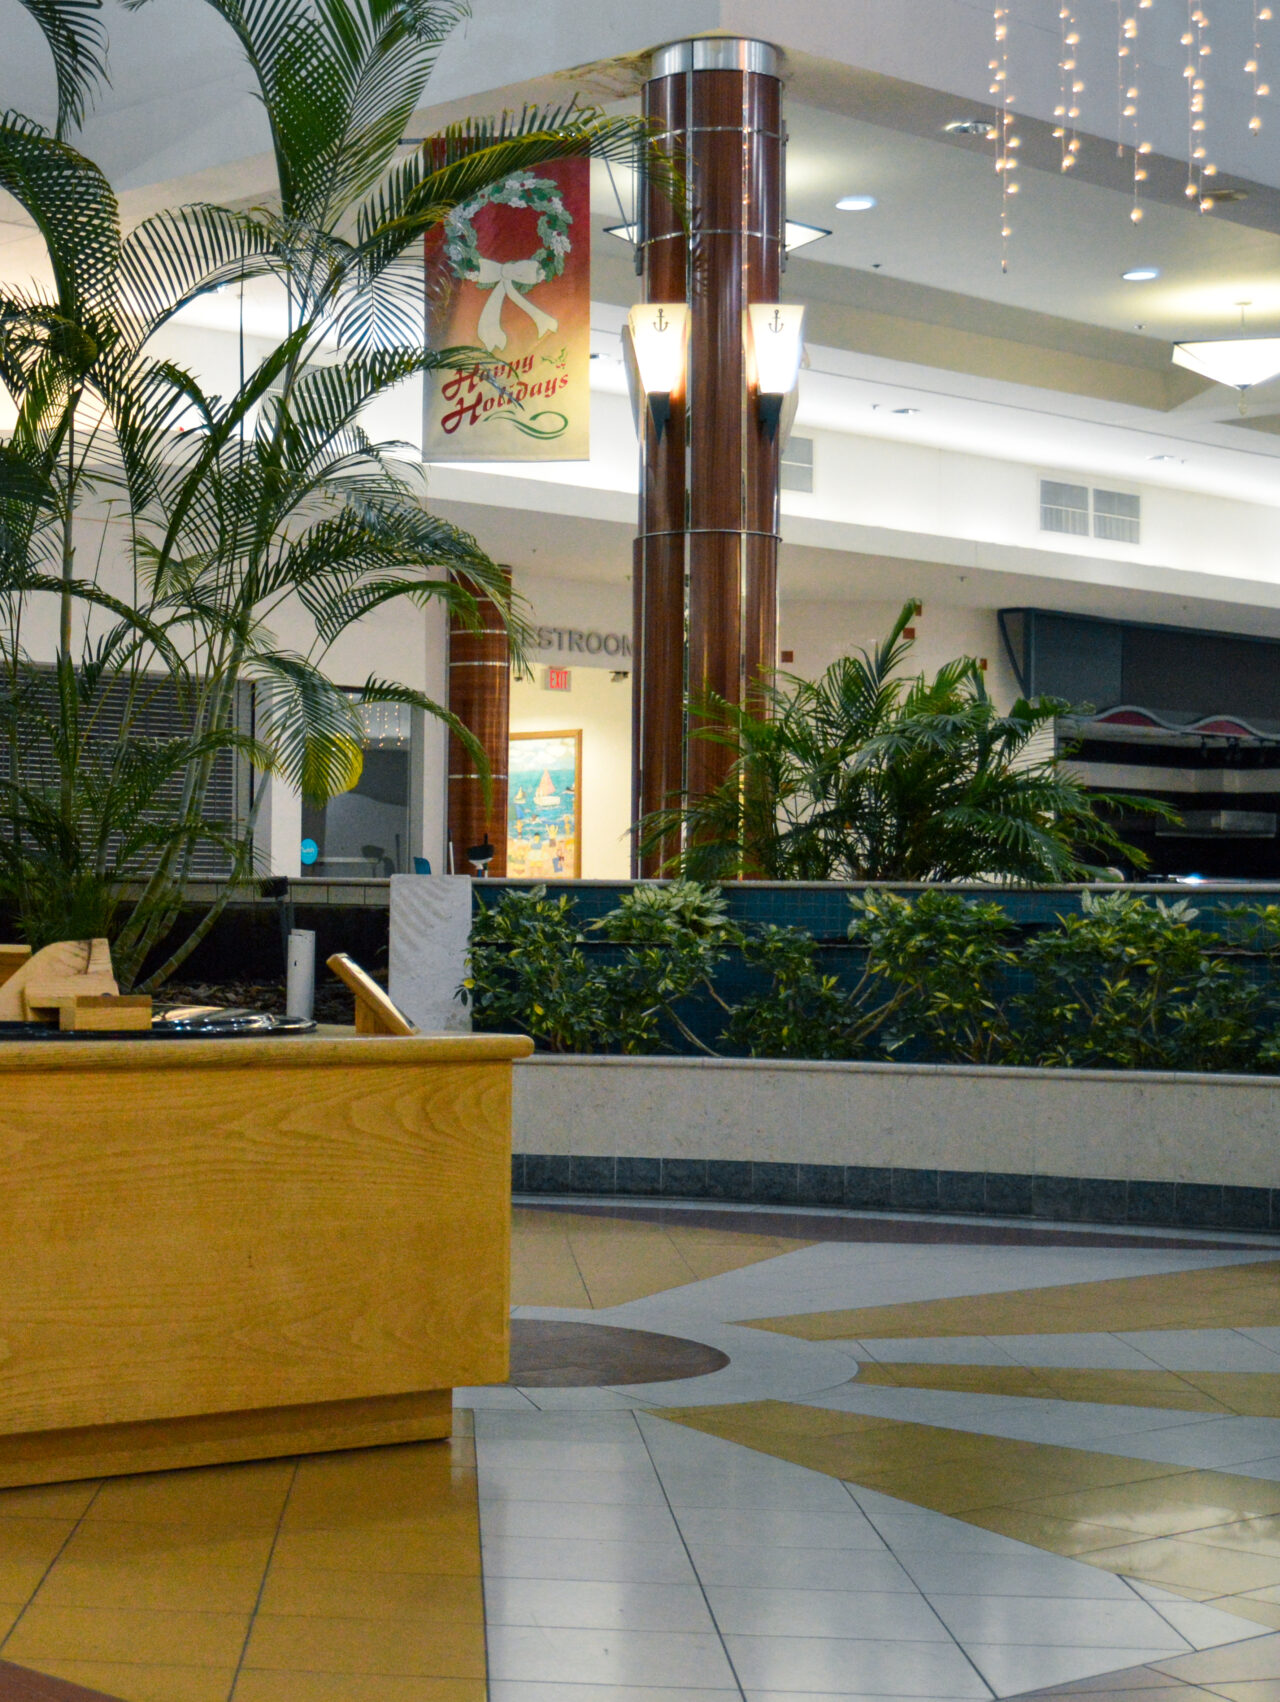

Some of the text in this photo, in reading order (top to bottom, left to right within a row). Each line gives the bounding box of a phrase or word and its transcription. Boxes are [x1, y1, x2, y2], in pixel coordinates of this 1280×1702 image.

[441, 374, 569, 434] Holidays
[514, 625, 633, 657] STROO
[549, 669, 569, 689] EXIT
